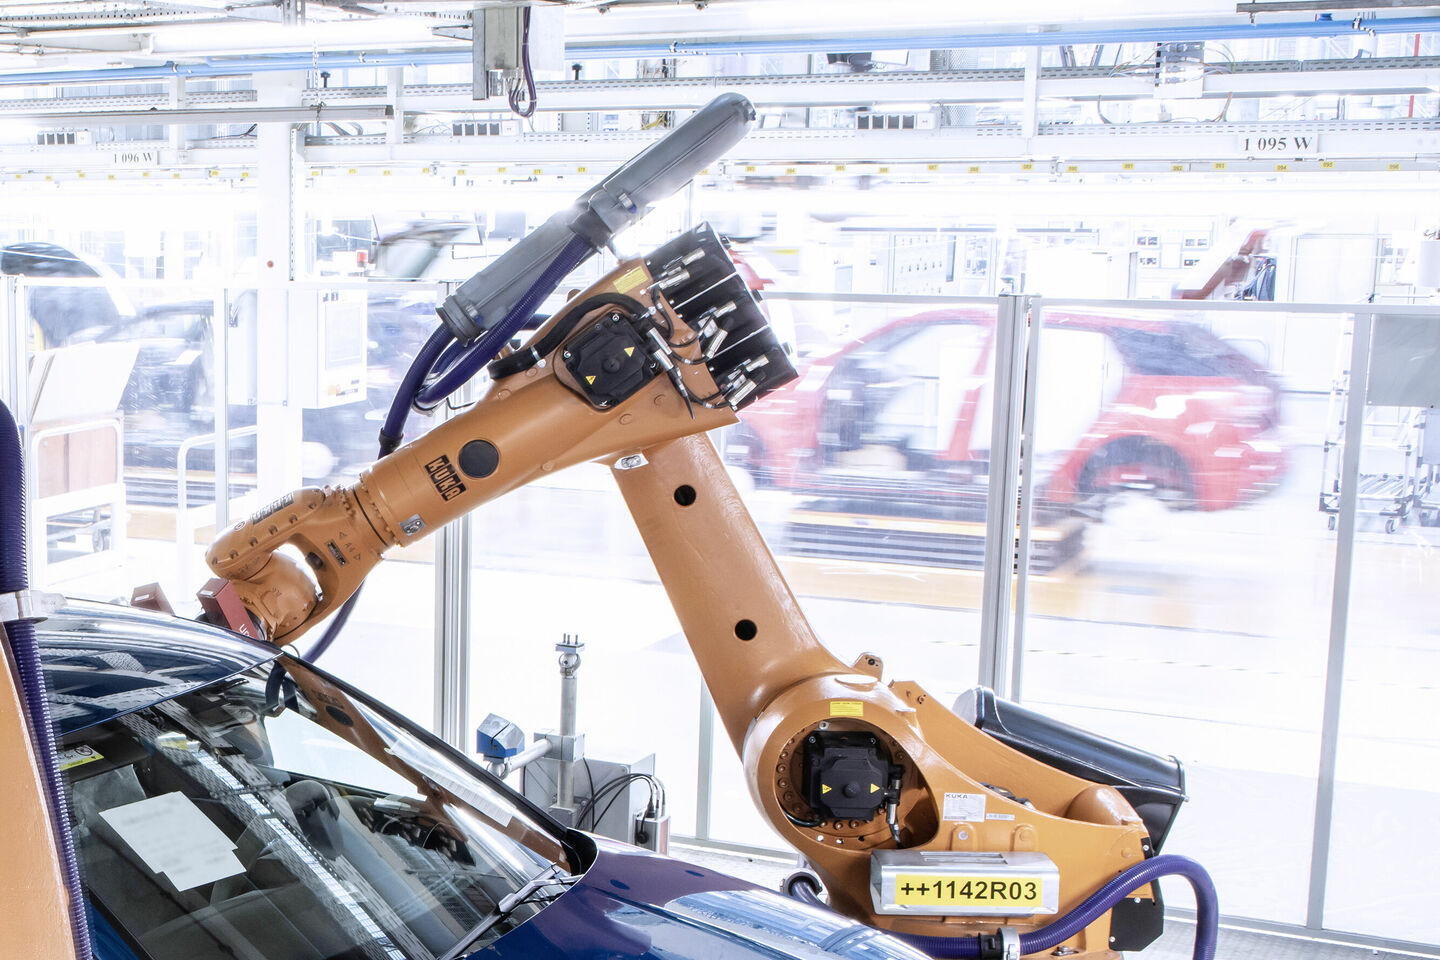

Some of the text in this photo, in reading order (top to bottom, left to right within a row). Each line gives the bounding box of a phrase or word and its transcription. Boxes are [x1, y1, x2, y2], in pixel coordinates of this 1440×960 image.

[1244, 136, 1313, 152] 1 095 W
[121, 152, 140, 163] 096
[142, 152, 154, 162] W
[426, 456, 465, 501] KUKA
[900, 880, 1037, 900] ++1142R03
